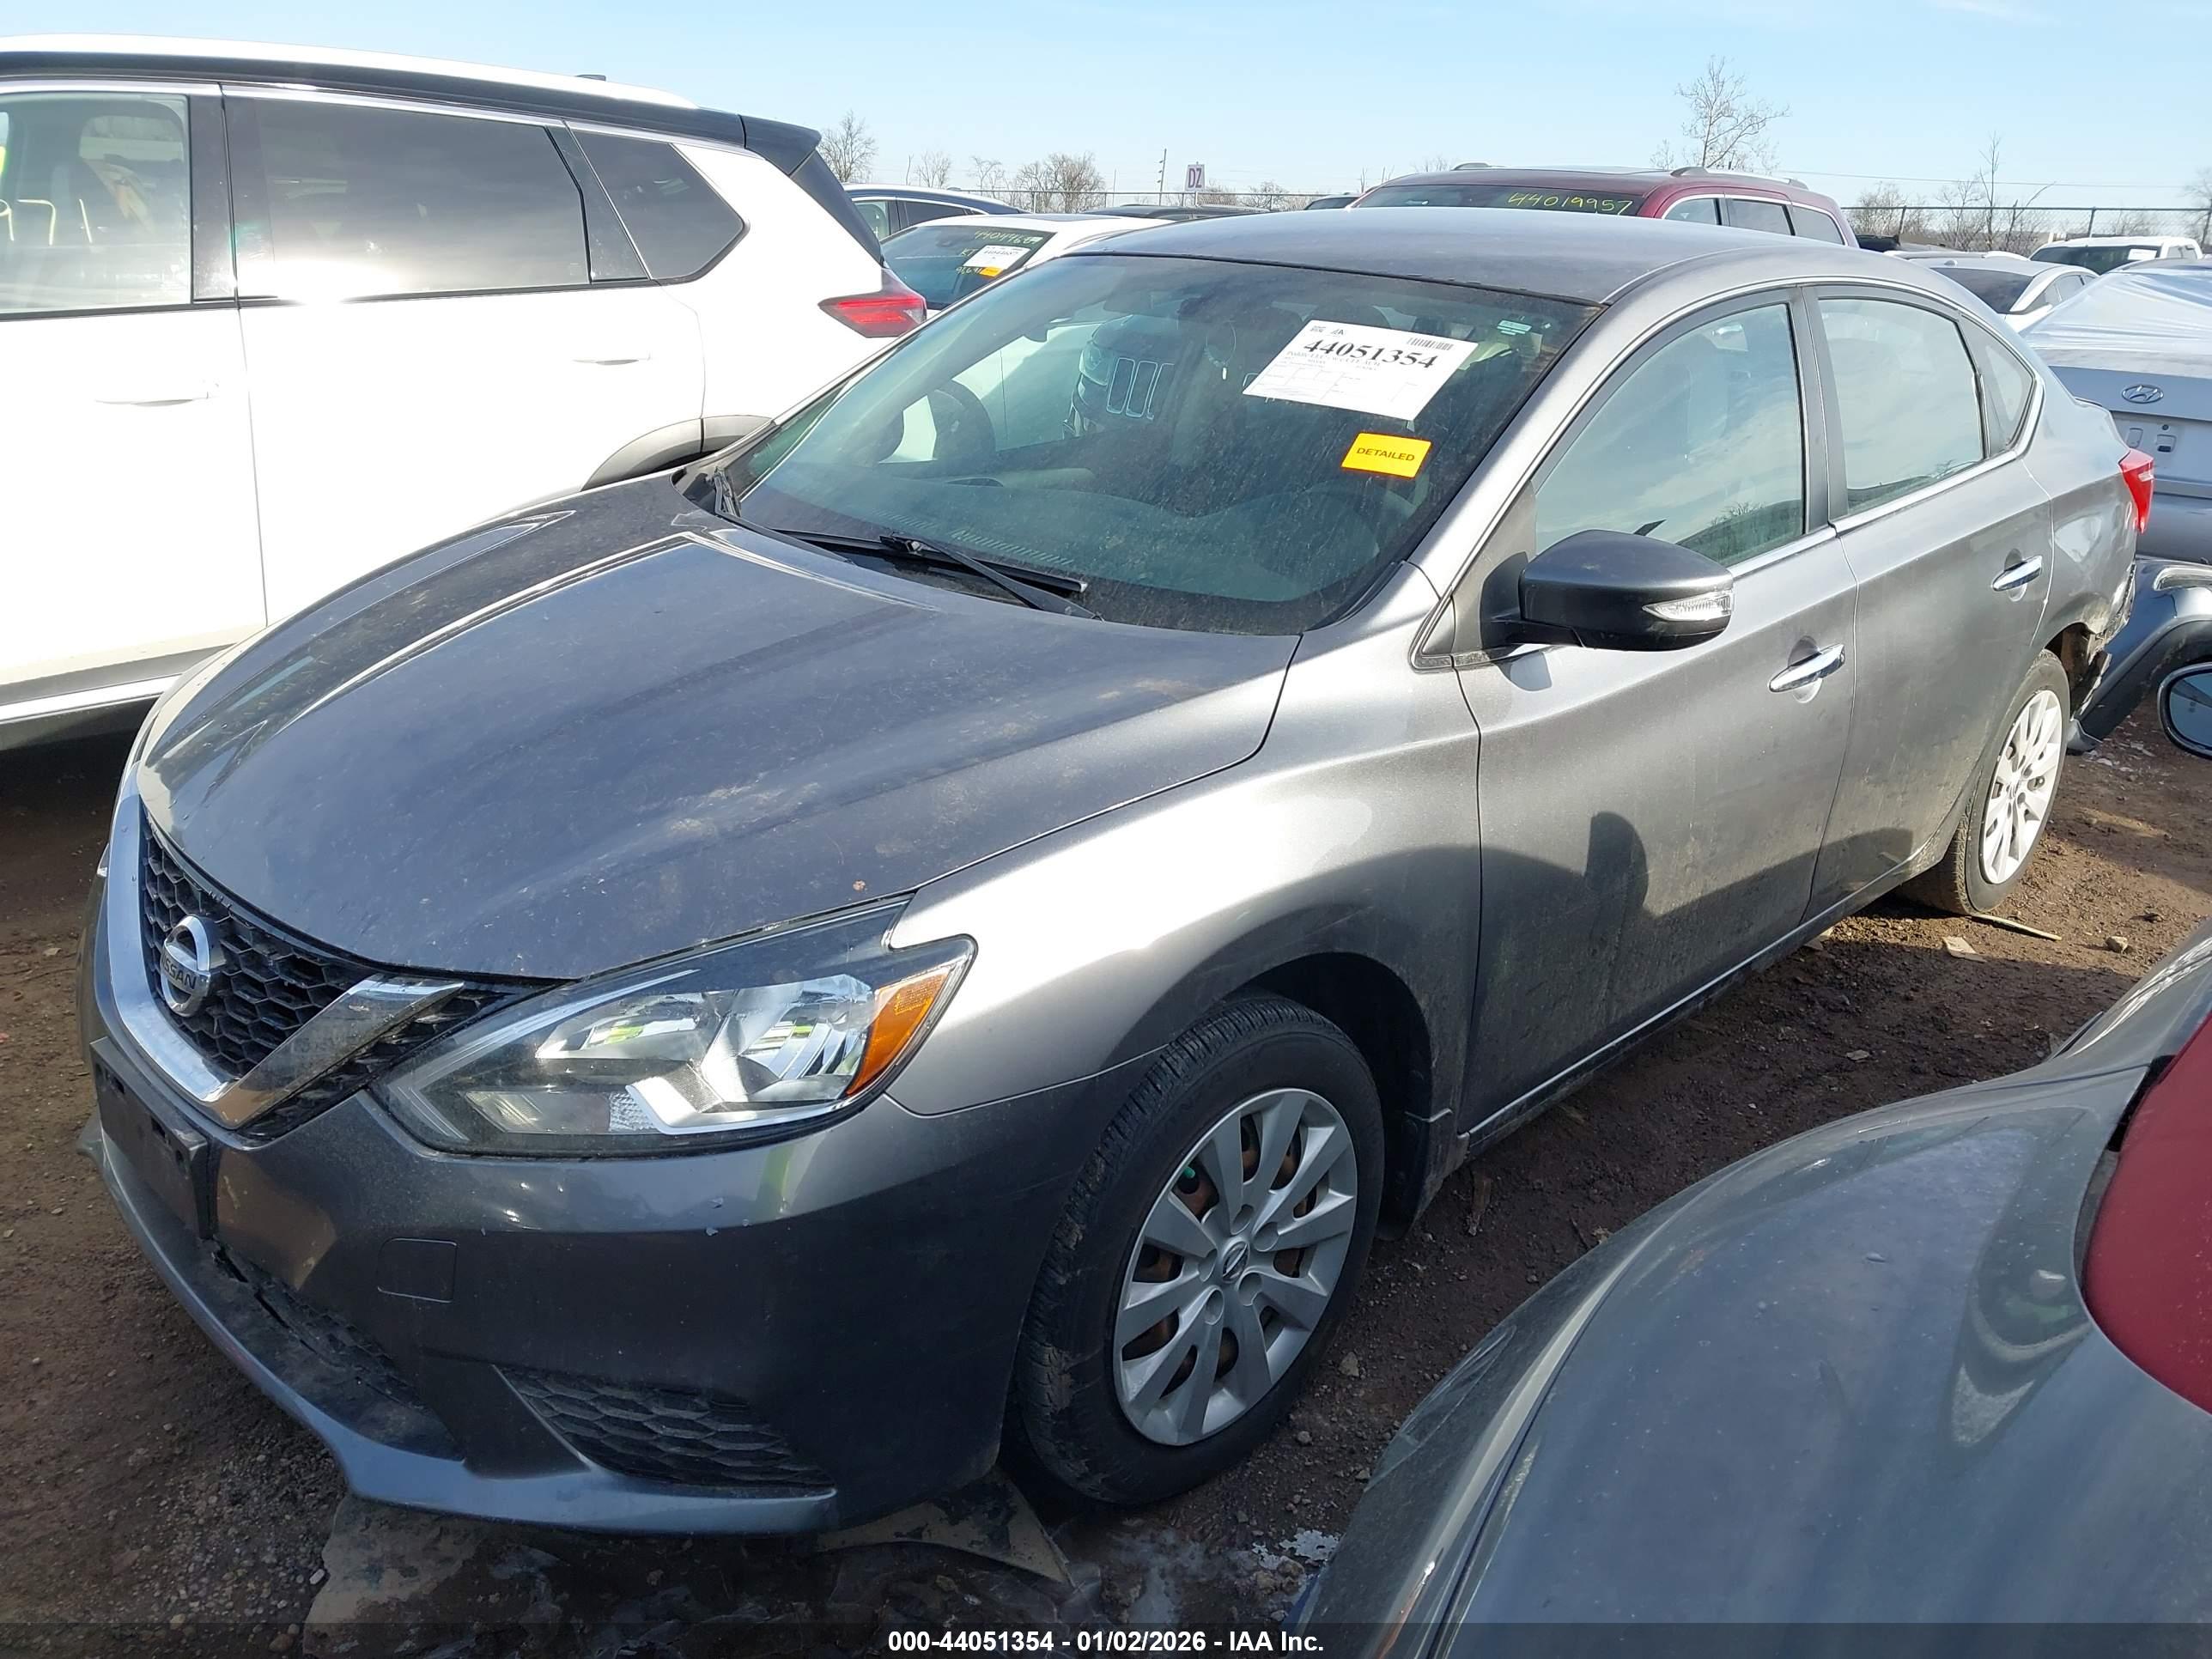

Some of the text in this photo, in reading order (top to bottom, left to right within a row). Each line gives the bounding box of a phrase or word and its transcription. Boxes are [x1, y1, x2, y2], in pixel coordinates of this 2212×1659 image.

[1508, 192, 1632, 216] 44019957
[1304, 339, 1438, 368] 44051354
[1357, 447, 1415, 461] DETAILED
